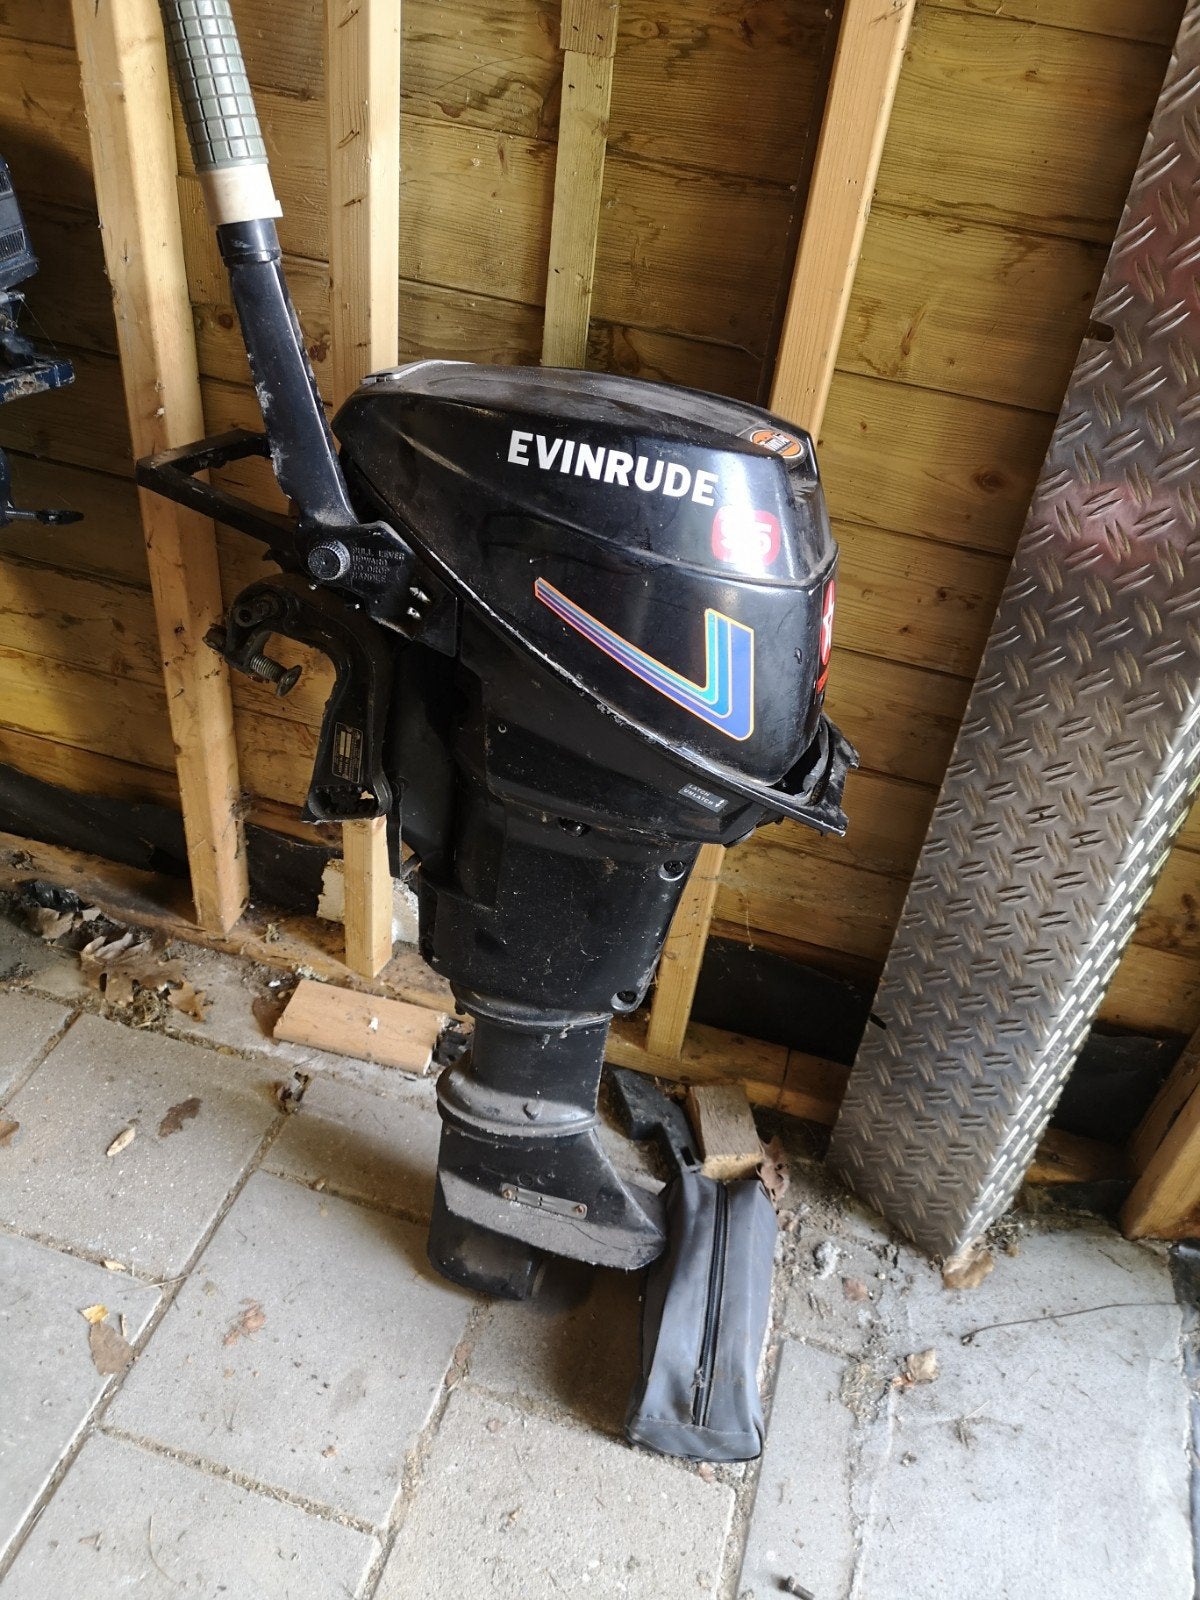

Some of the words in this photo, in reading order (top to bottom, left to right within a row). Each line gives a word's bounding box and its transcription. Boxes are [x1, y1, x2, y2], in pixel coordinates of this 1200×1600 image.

[507, 430, 719, 506] EVINRUDE
[378, 550, 405, 560] LEVER
[352, 562, 364, 571] TO
[683, 788, 714, 805] UNLATCH
[688, 784, 710, 797] LATCH
